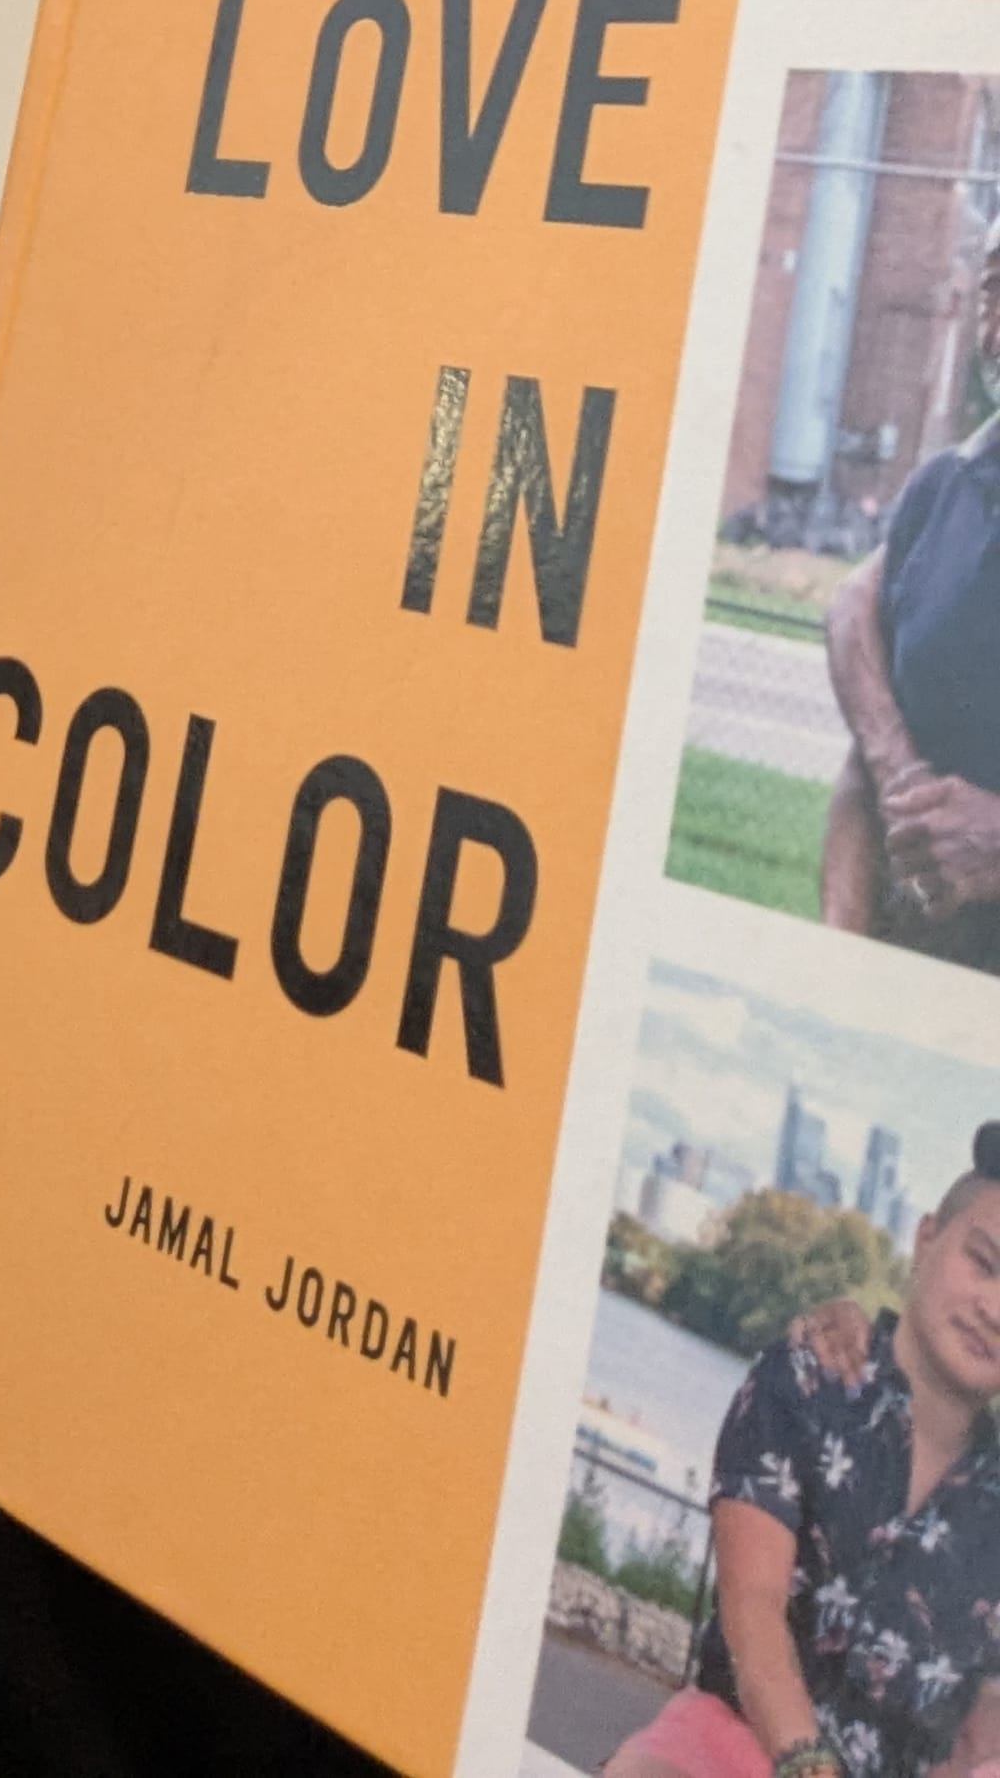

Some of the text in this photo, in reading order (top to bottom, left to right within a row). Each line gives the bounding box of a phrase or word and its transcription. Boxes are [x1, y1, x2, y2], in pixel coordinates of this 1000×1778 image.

[400, 366, 615, 647] IN
[104, 1175, 456, 1398] JAMAL JORDAN
